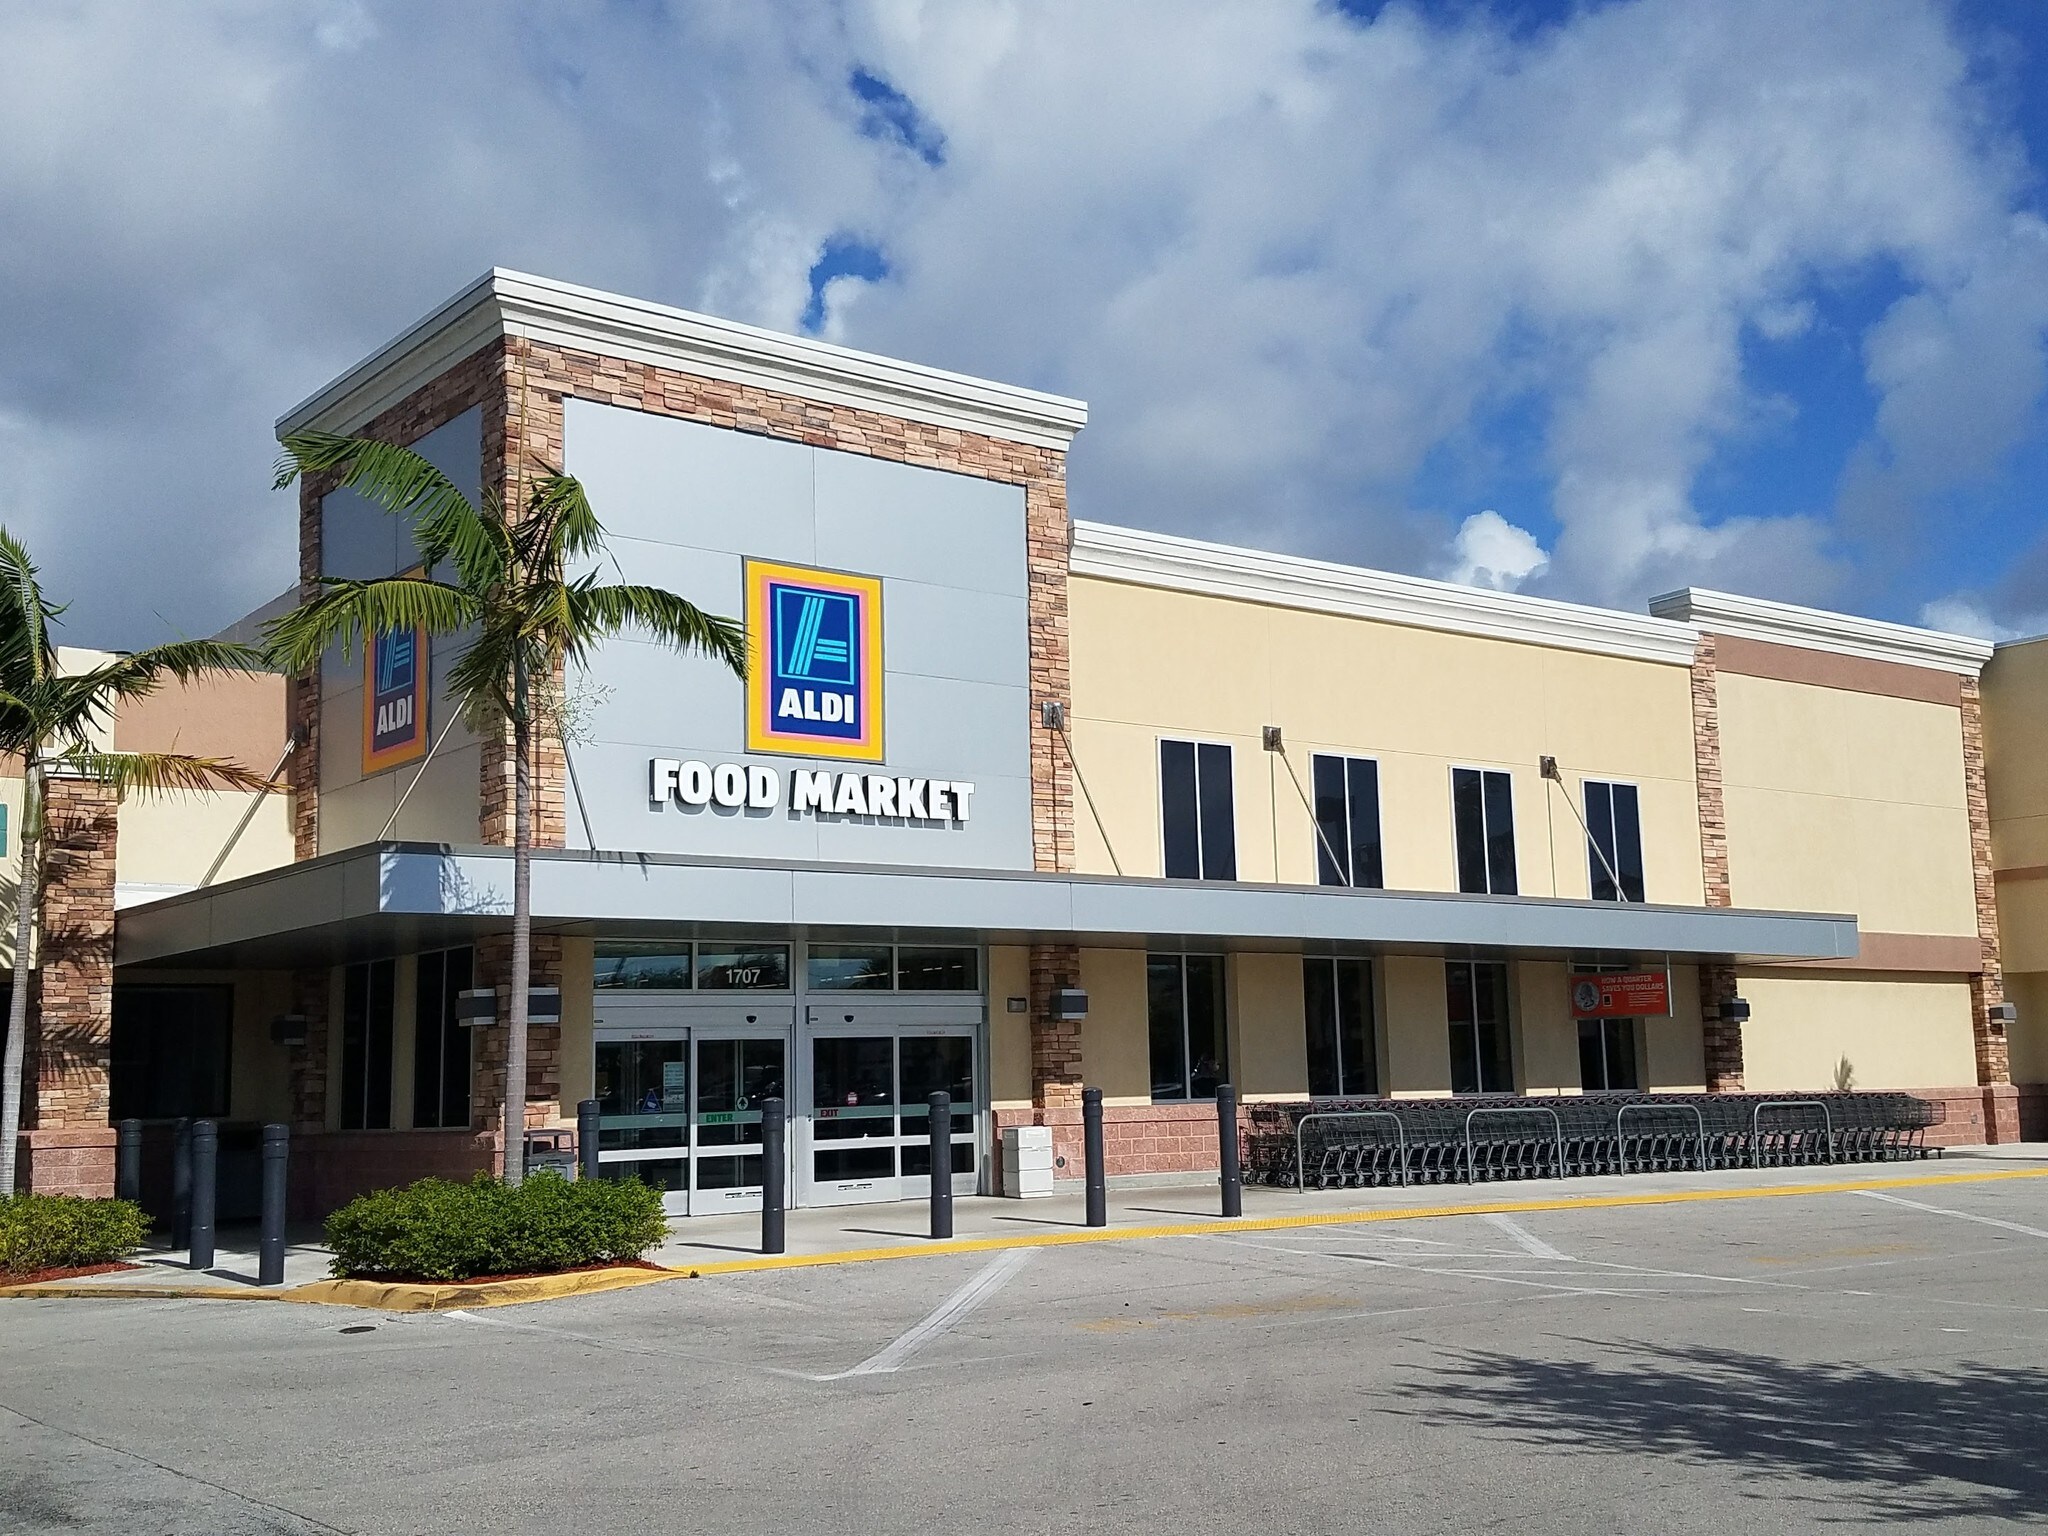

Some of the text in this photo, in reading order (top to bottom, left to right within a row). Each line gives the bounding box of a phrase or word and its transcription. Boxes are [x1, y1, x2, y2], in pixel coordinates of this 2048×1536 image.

[777, 688, 854, 724] ALDI
[376, 694, 413, 736] ALDI
[651, 758, 976, 821] FOOD MARKET
[725, 968, 761, 984] 1707
[1623, 975, 1652, 983] QUARTER
[1602, 984, 1621, 992] SAVES
[706, 1113, 733, 1123] ENTER
[820, 1108, 839, 1118] EXIT
